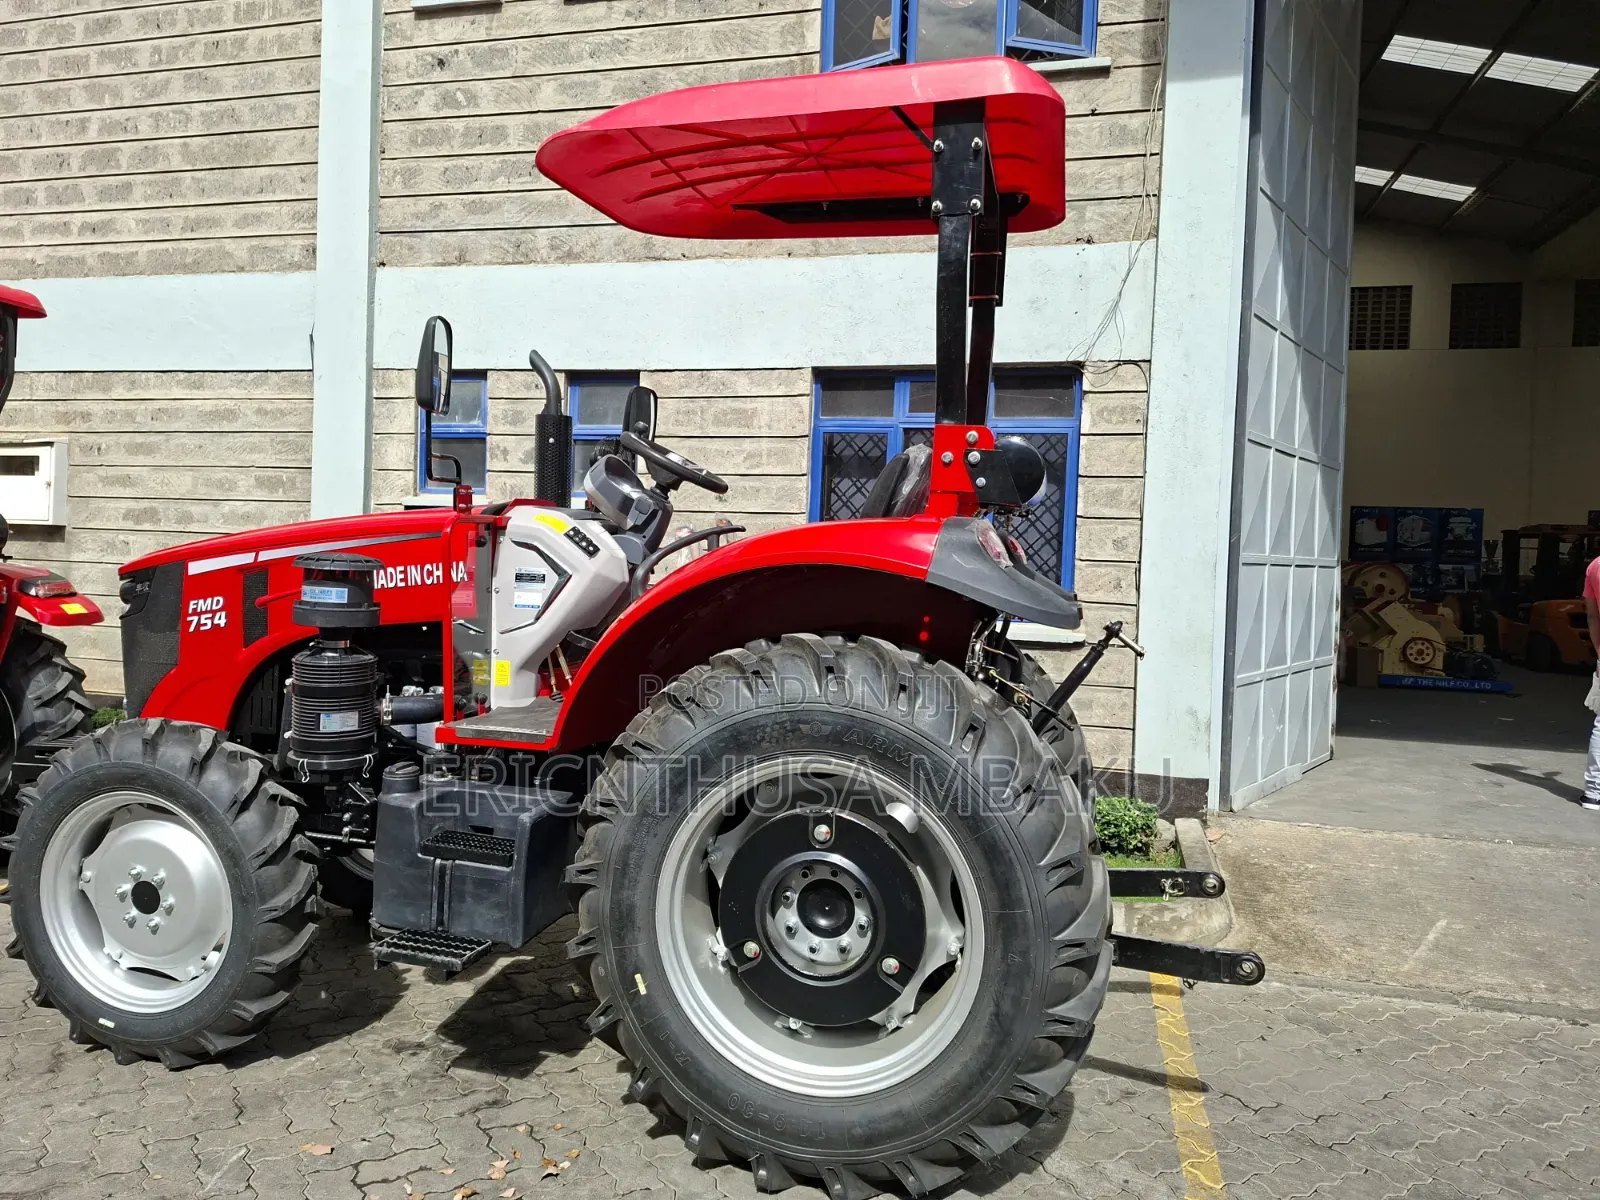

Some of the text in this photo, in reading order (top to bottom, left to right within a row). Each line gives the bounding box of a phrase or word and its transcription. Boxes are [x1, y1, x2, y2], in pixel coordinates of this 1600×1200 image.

[407, 564, 422, 587] IN
[424, 560, 468, 585] CHNA
[188, 596, 225, 614] FMD
[186, 611, 227, 632] 754
[1416, 678, 1434, 686] THE
[659, 1031, 691, 1067] R-1
